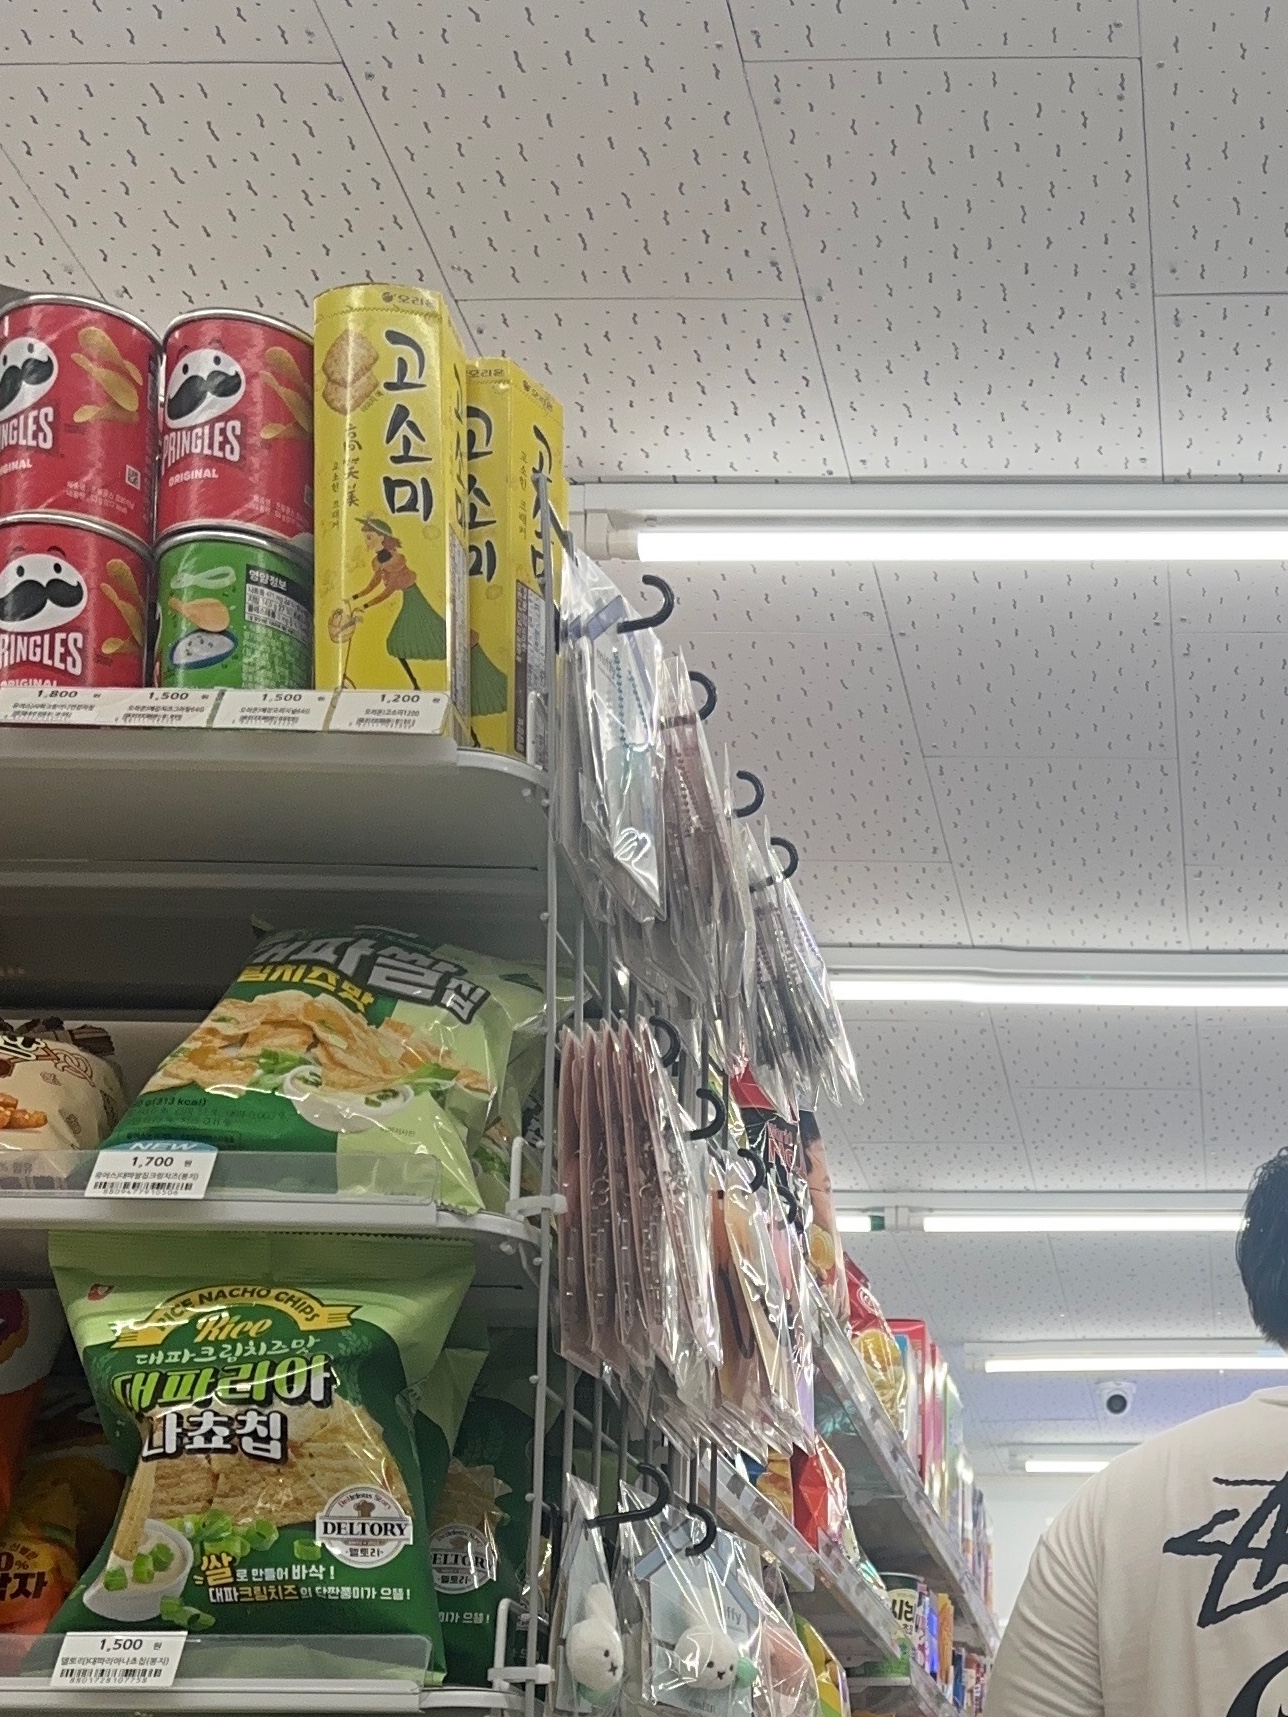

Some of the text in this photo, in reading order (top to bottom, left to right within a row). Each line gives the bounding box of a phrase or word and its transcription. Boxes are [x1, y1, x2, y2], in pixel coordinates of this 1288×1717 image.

[161, 419, 242, 476] PRINGLES
[168, 467, 219, 488] ORIGINAL
[37, 690, 78, 699] 1,800
[148, 691, 189, 700] 1,500
[261, 693, 302, 702] 1,500
[379, 694, 421, 703] 1,200
[131, 1156, 174, 1169] 1,700
[197, 1287, 271, 1304] NACHO
[274, 1290, 321, 1323] CHIPS
[193, 1312, 273, 1343] Rice
[135, 1334, 321, 1367] 대파크림치즈맛
[111, 1353, 332, 1413] 대파리아
[140, 1409, 284, 1461] 나쵸칩
[322, 1519, 410, 1538] DELTORY
[251, 1567, 289, 1582] 만들어
[291, 1562, 326, 1581] 바삭
[99, 1638, 143, 1652] 1,500
